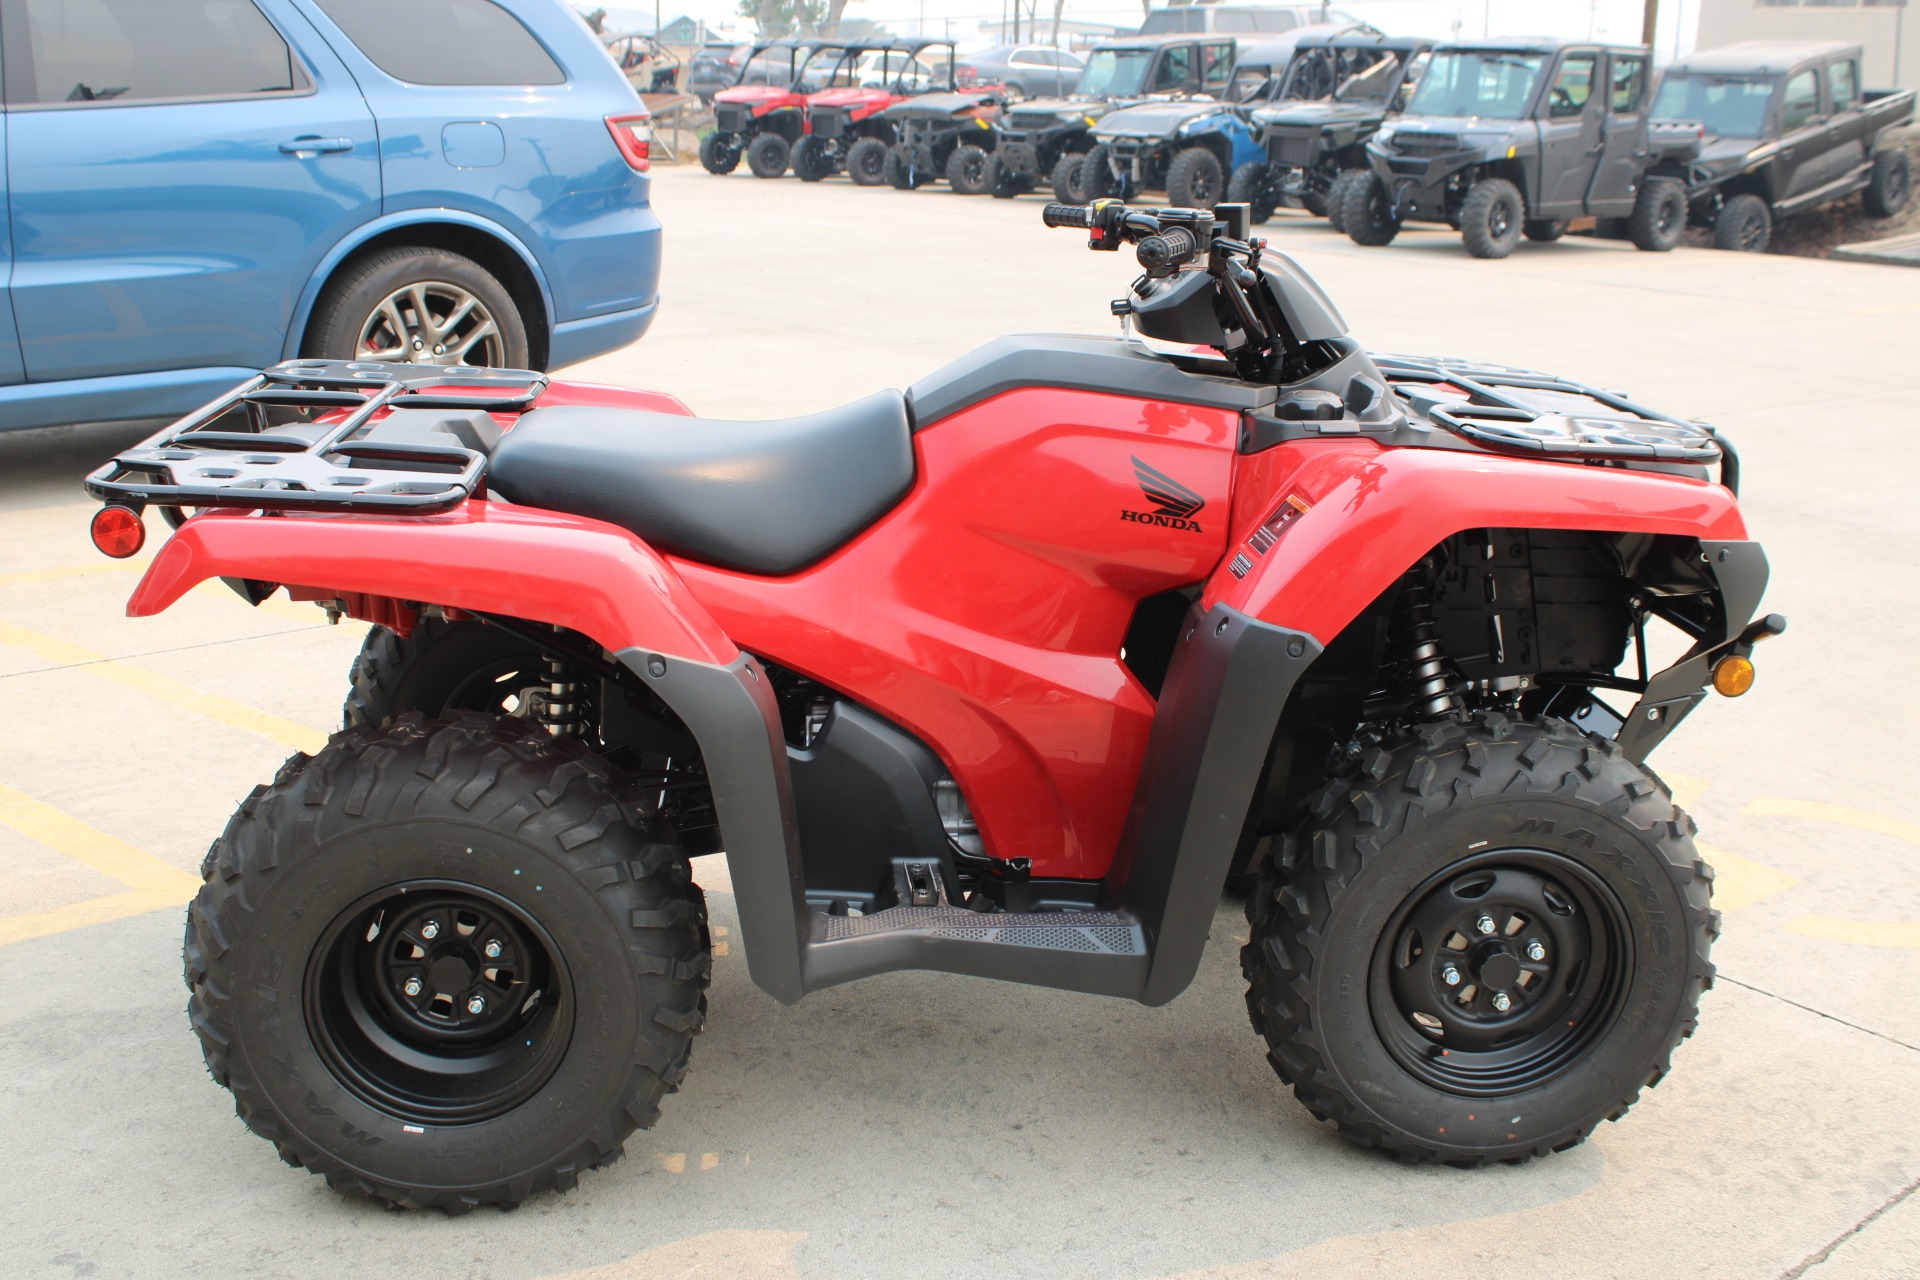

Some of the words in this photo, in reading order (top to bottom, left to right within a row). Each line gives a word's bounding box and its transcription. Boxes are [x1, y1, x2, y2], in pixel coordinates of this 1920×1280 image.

[1120, 509, 1203, 533] HONDA
[1511, 817, 1672, 957] MAXXIS
[257, 949, 387, 1150] MAXXIS
